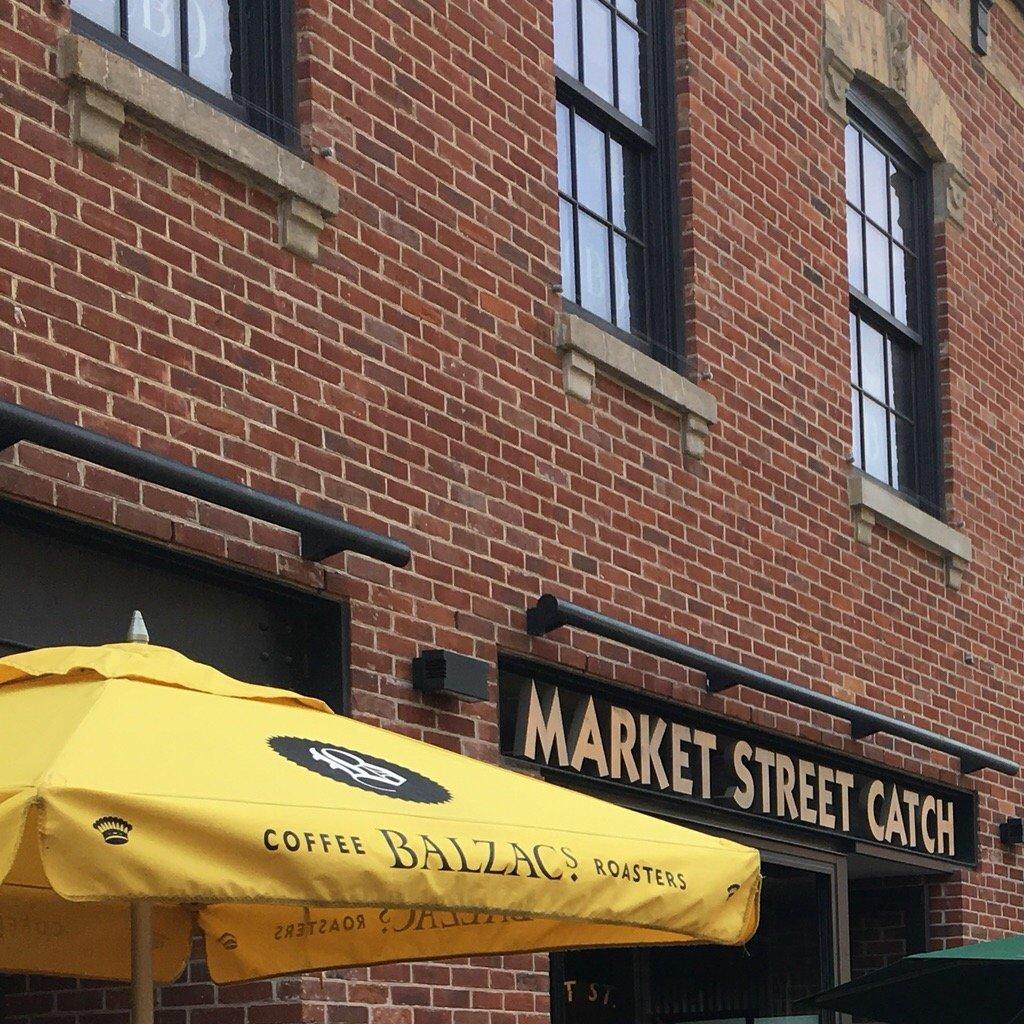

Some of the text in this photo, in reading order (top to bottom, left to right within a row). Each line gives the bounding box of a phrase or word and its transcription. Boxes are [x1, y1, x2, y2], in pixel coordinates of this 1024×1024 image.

[523, 679, 956, 857] MARKET STREET CATCH
[263, 828, 367, 855] COFFEE
[594, 858, 687, 890] ROASTERS
